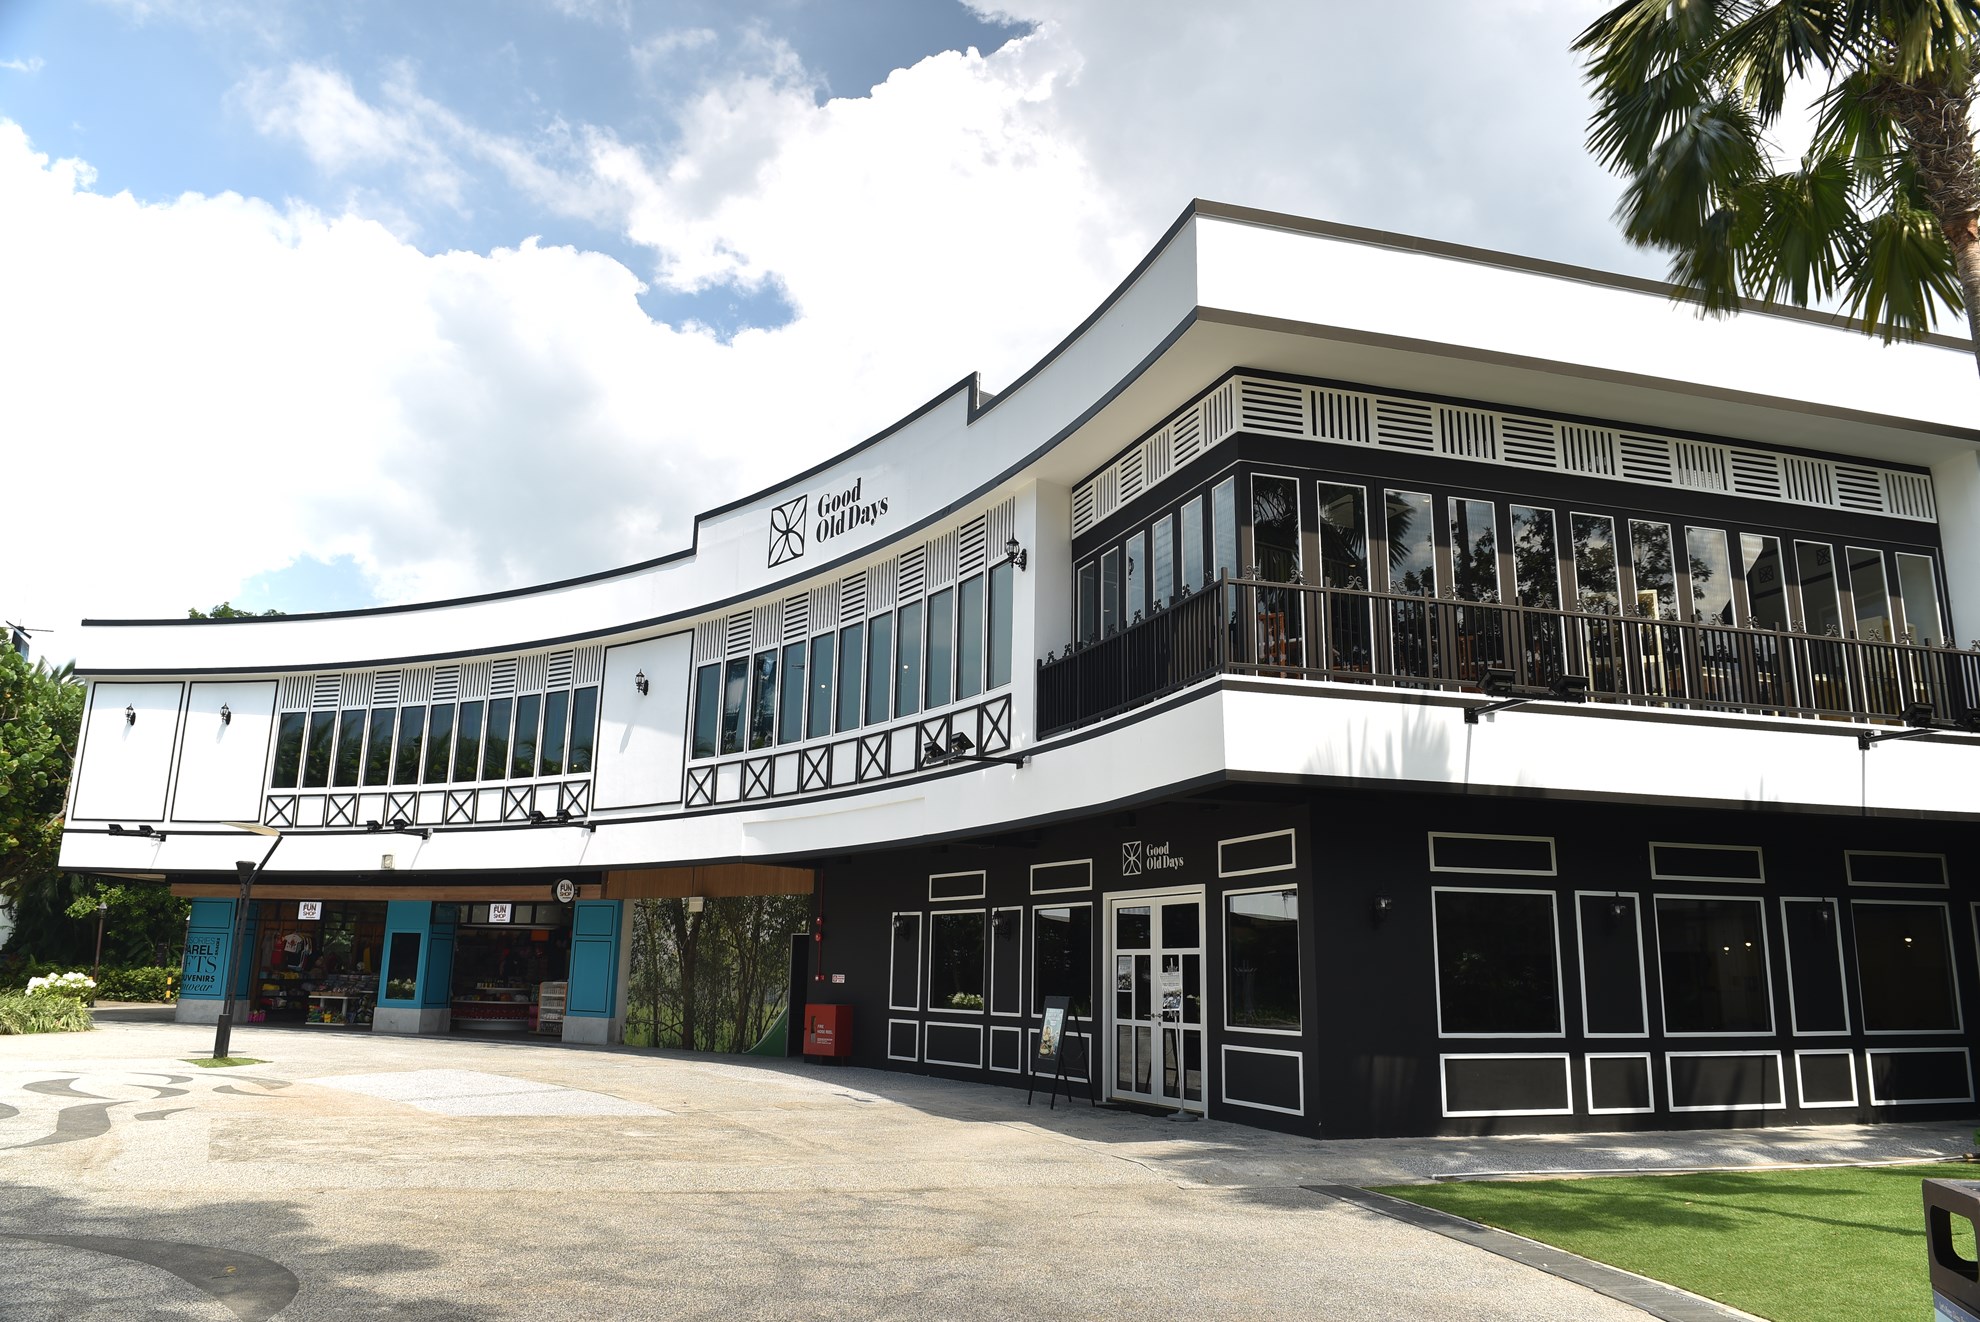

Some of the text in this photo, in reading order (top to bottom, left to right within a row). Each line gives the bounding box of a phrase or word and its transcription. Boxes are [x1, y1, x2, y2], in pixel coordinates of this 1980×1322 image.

[817, 477, 862, 518] Good
[816, 496, 889, 543] Old Days
[1146, 841, 1169, 857] Good
[1146, 855, 1184, 870] Old Days
[303, 902, 316, 910] FUN
[494, 905, 506, 913] FUN
